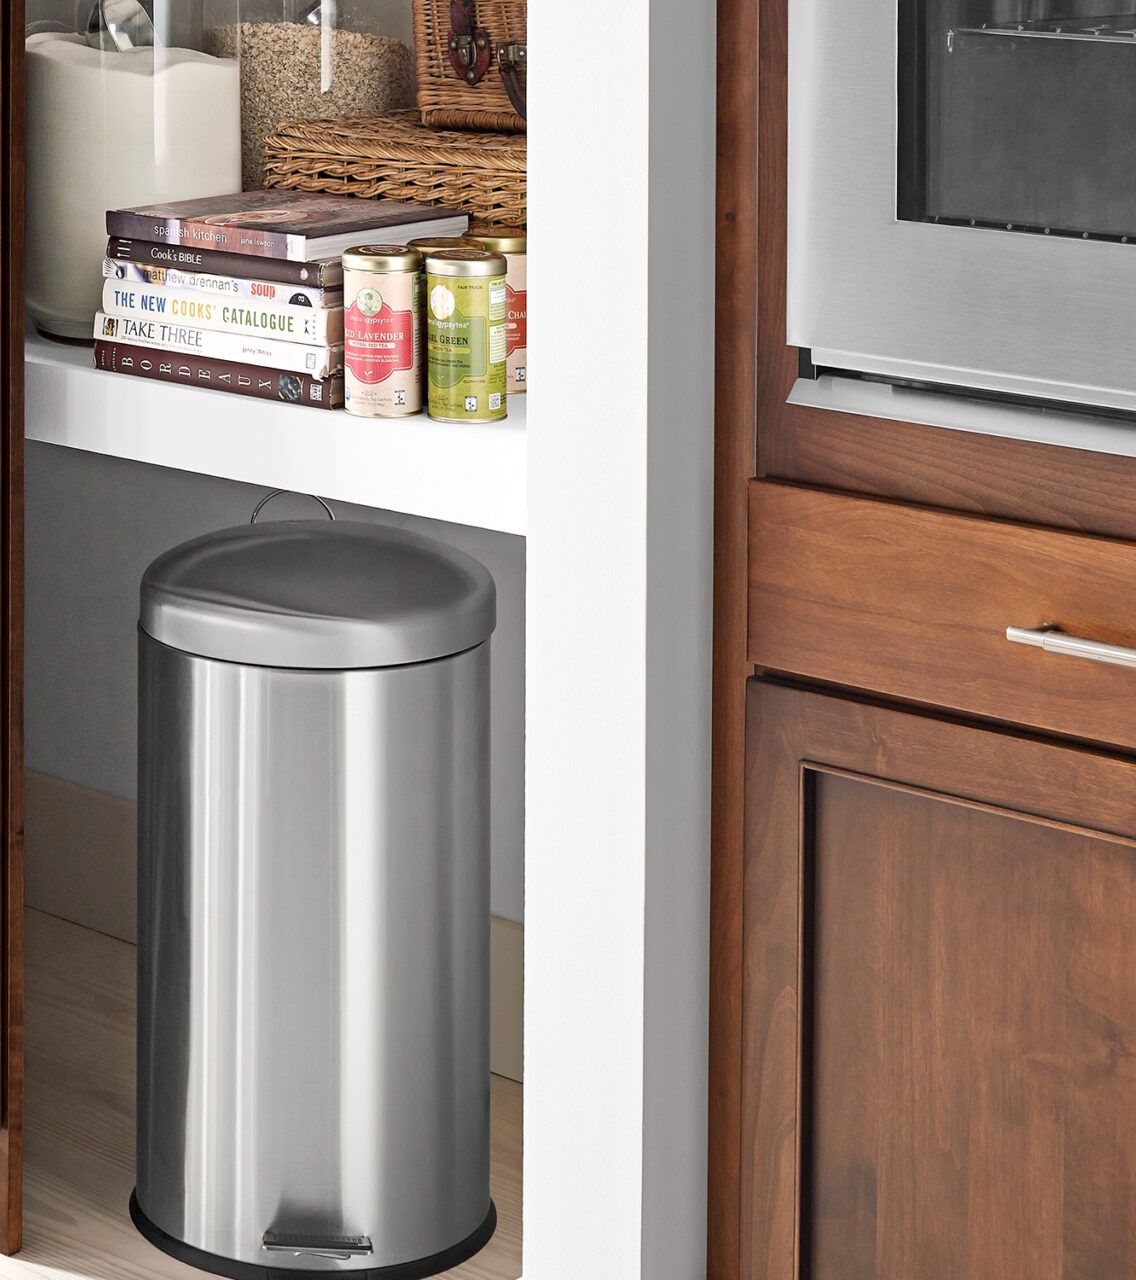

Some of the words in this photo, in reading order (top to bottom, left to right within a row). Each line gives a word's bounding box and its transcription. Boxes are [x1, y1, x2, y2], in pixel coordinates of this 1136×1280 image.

[153, 225, 190, 240] spanish
[192, 229, 227, 244] kitchen
[240, 238, 252, 247] jane
[150, 247, 177, 262] Cook's
[178, 252, 202, 265] BIBLE
[143, 269, 185, 285] matthew
[189, 275, 239, 293] drennan's
[251, 282, 276, 299] soup
[114, 290, 135, 309] THE
[141, 294, 166, 313] NEW
[172, 298, 216, 320] COOKS'
[222, 307, 294, 332] CATALOGUE
[123, 319, 155, 338] TAKE
[160, 325, 203, 348] THREE
[358, 330, 404, 341] LAVENDER
[439, 334, 469, 345] GREEN
[121, 355, 272, 390] BORDEAUX
